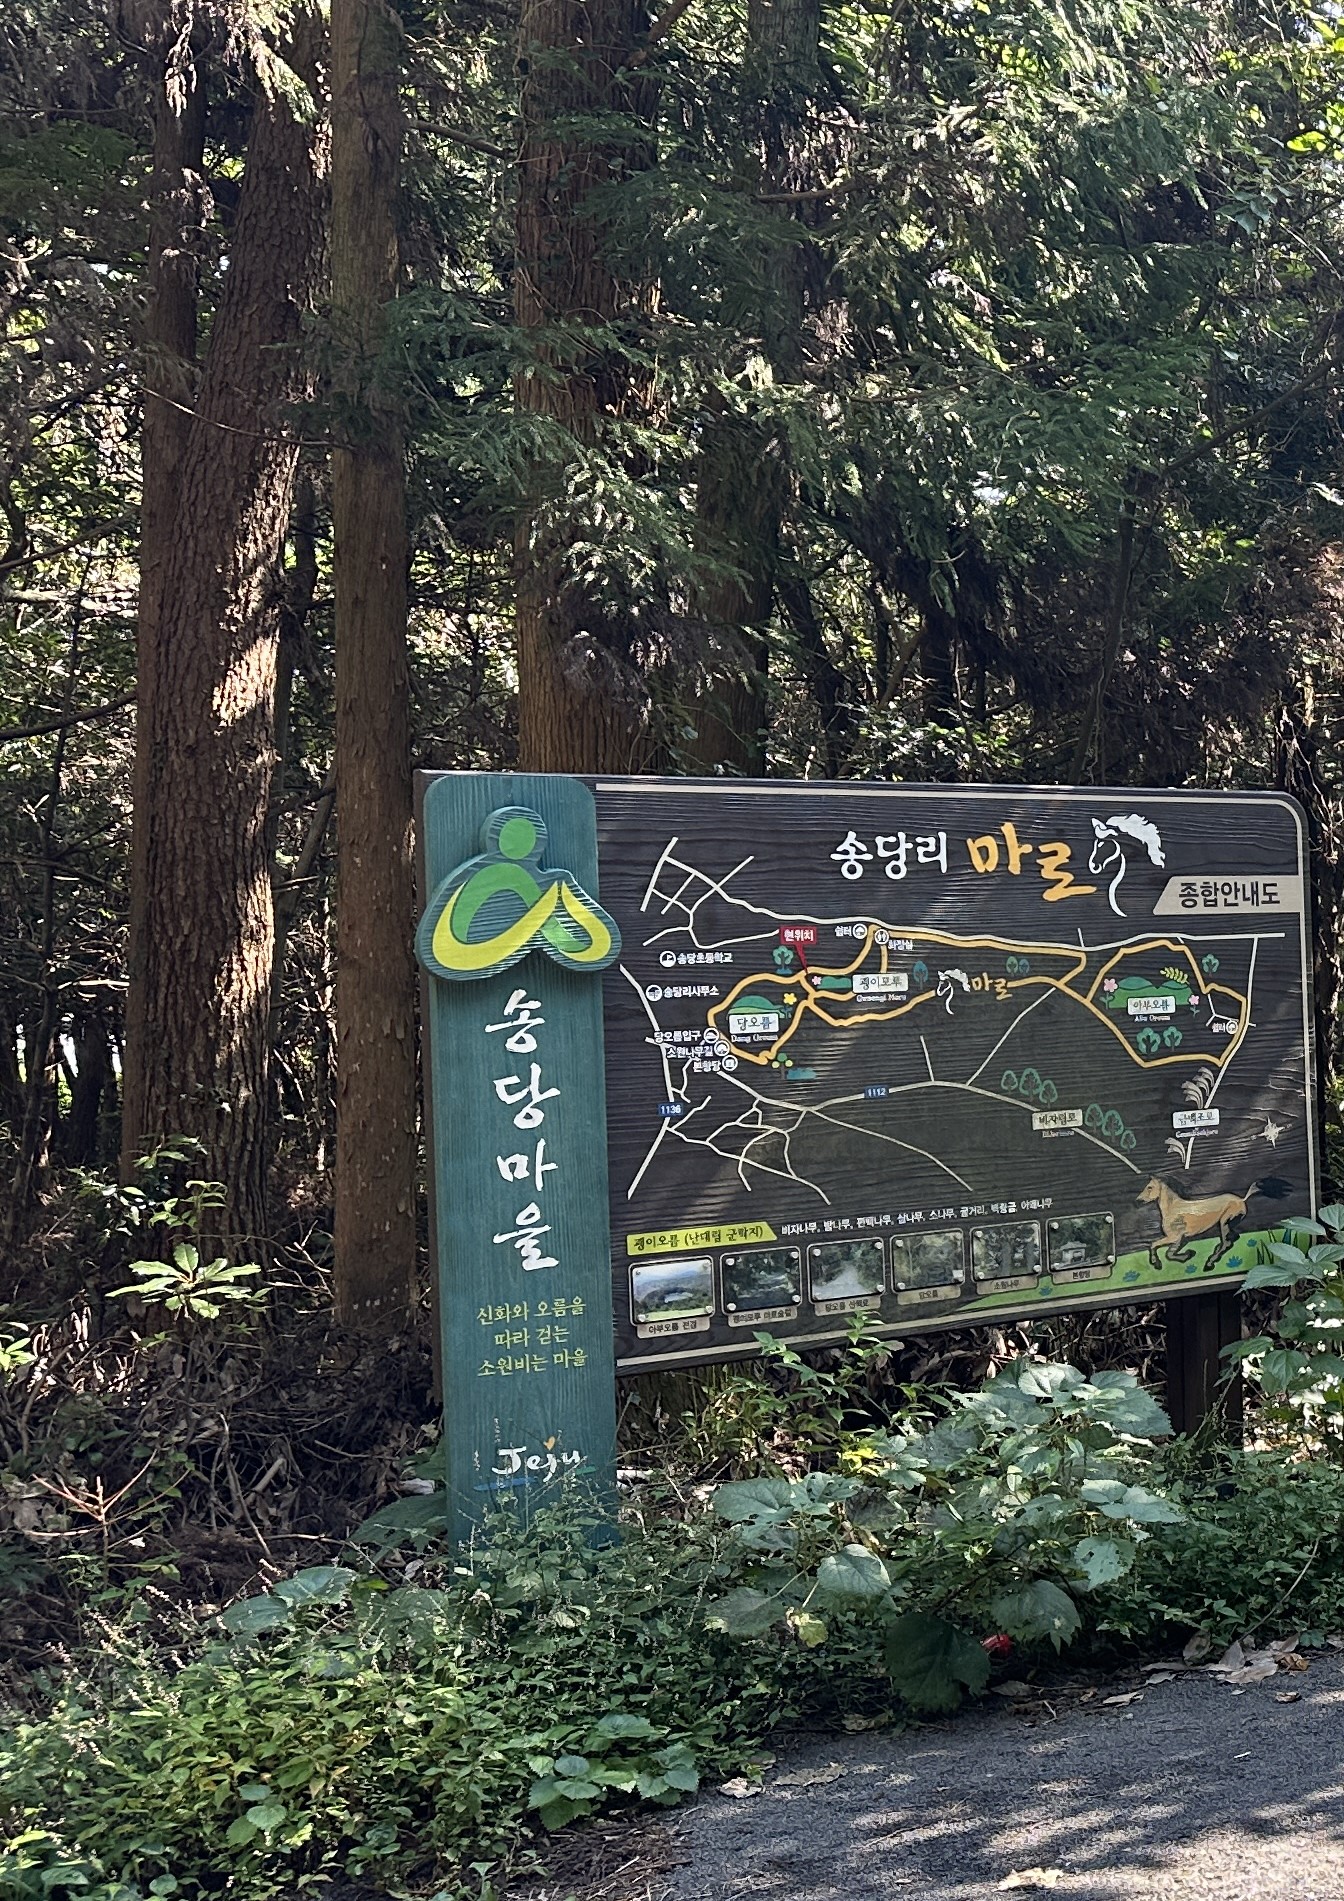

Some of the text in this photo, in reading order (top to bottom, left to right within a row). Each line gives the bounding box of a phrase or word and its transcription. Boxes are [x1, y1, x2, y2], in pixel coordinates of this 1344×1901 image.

[830, 822, 1097, 901] 송당리 마로
[1178, 880, 1280, 909] 종합안내도
[784, 929, 814, 942] 현위치
[677, 952, 733, 964] 송당초등학교
[654, 1031, 701, 1043] 당오름입구
[867, 1088, 886, 1097] 1112
[660, 1105, 681, 1114] 1136
[485, 988, 561, 1271] 송당마을
[476, 1295, 587, 1326] 신화와 오름을
[495, 1324, 570, 1350] 따라 걷는
[477, 1348, 588, 1377] 소원비는 마을
[491, 1437, 580, 1483] Jeju
